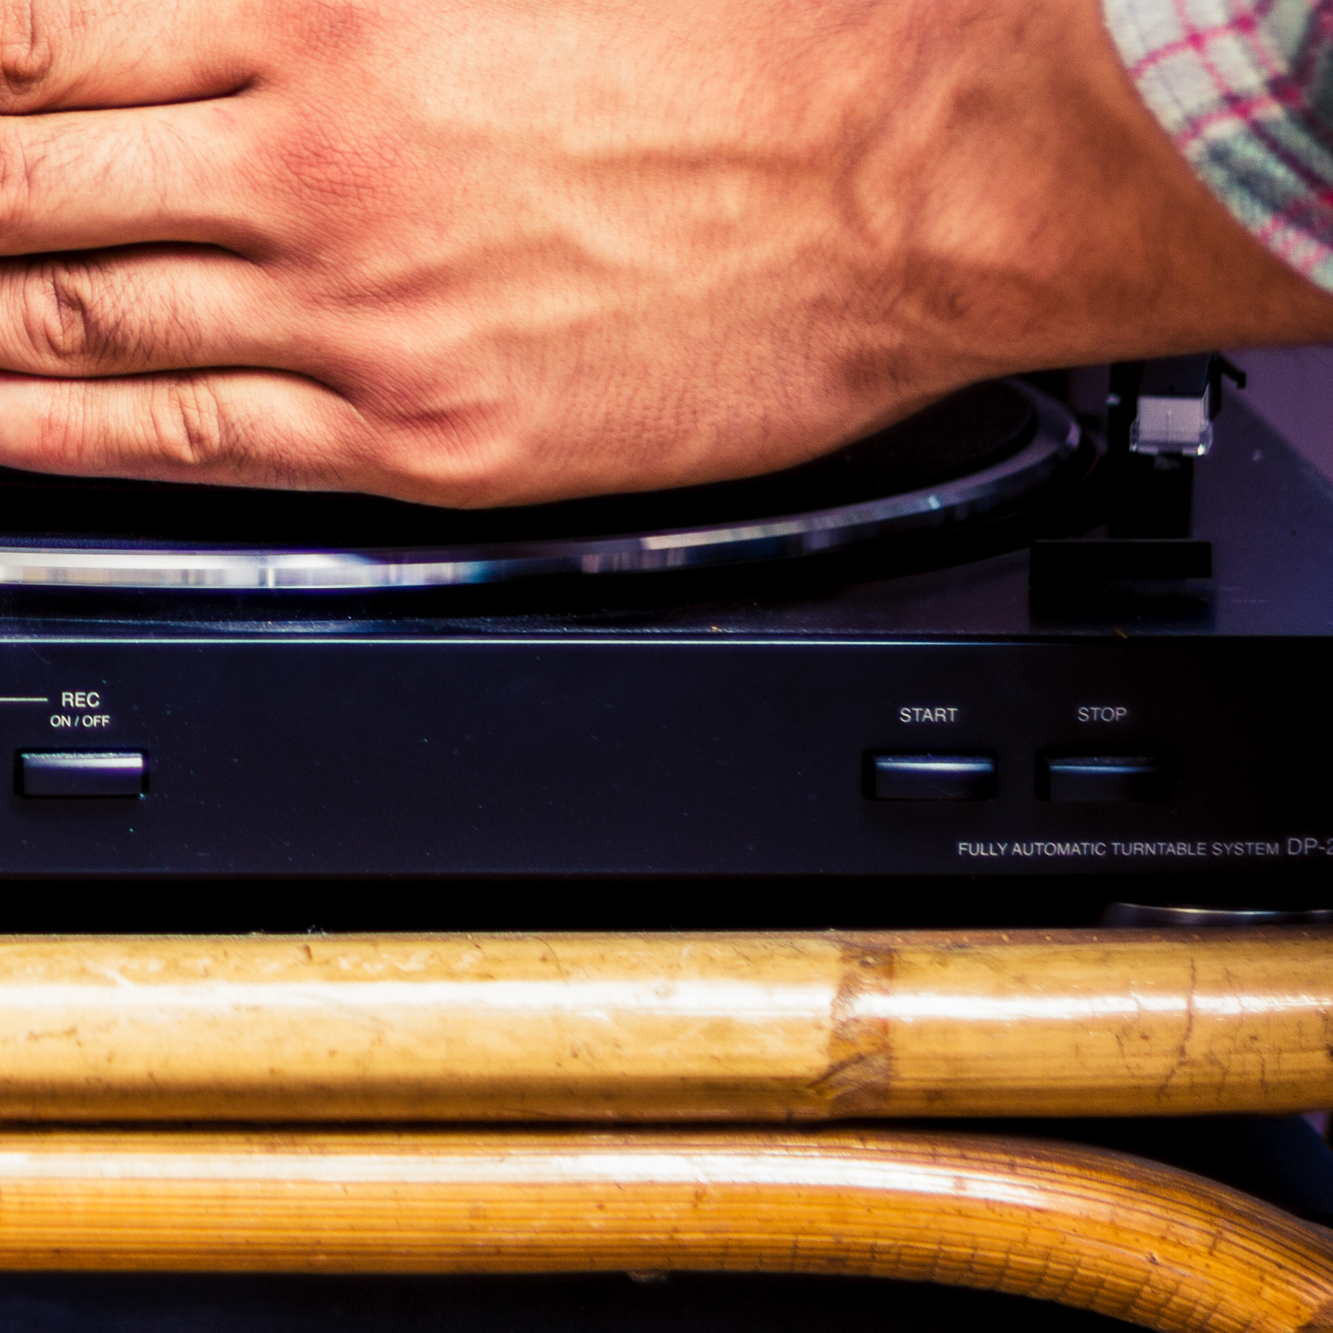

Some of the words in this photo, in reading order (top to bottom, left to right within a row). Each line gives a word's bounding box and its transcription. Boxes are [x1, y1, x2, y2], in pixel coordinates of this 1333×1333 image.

[61, 691, 100, 708] REC
[899, 707, 958, 724] START
[1077, 706, 1128, 723] STOP
[958, 841, 1009, 857] FULLY
[1011, 841, 1108, 857] AUTOMATIC
[1110, 841, 1208, 857] TURNTABLE
[1211, 841, 1280, 857] SYSTEM
